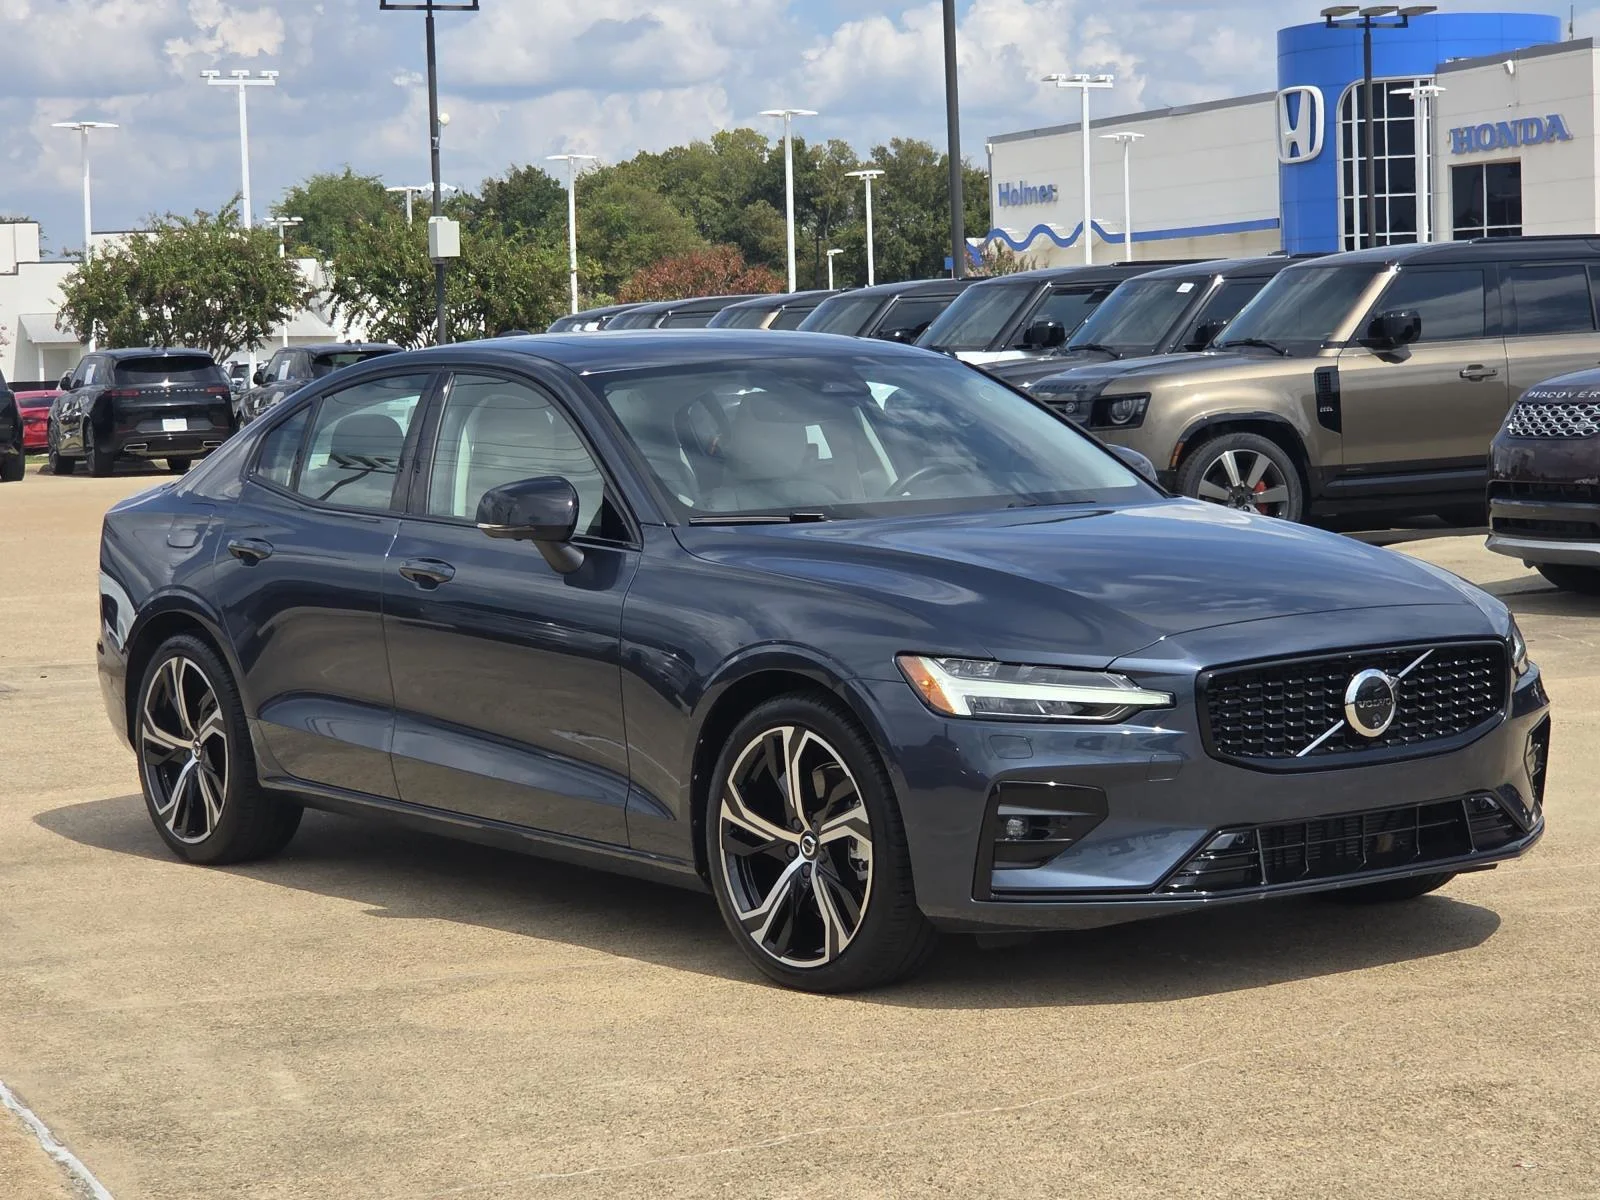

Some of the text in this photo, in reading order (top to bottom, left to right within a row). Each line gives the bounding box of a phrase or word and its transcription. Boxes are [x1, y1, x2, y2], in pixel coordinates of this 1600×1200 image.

[1449, 113, 1573, 155] HONDA
[997, 180, 1057, 207] Holmes
[1357, 697, 1391, 708] VOLVO
